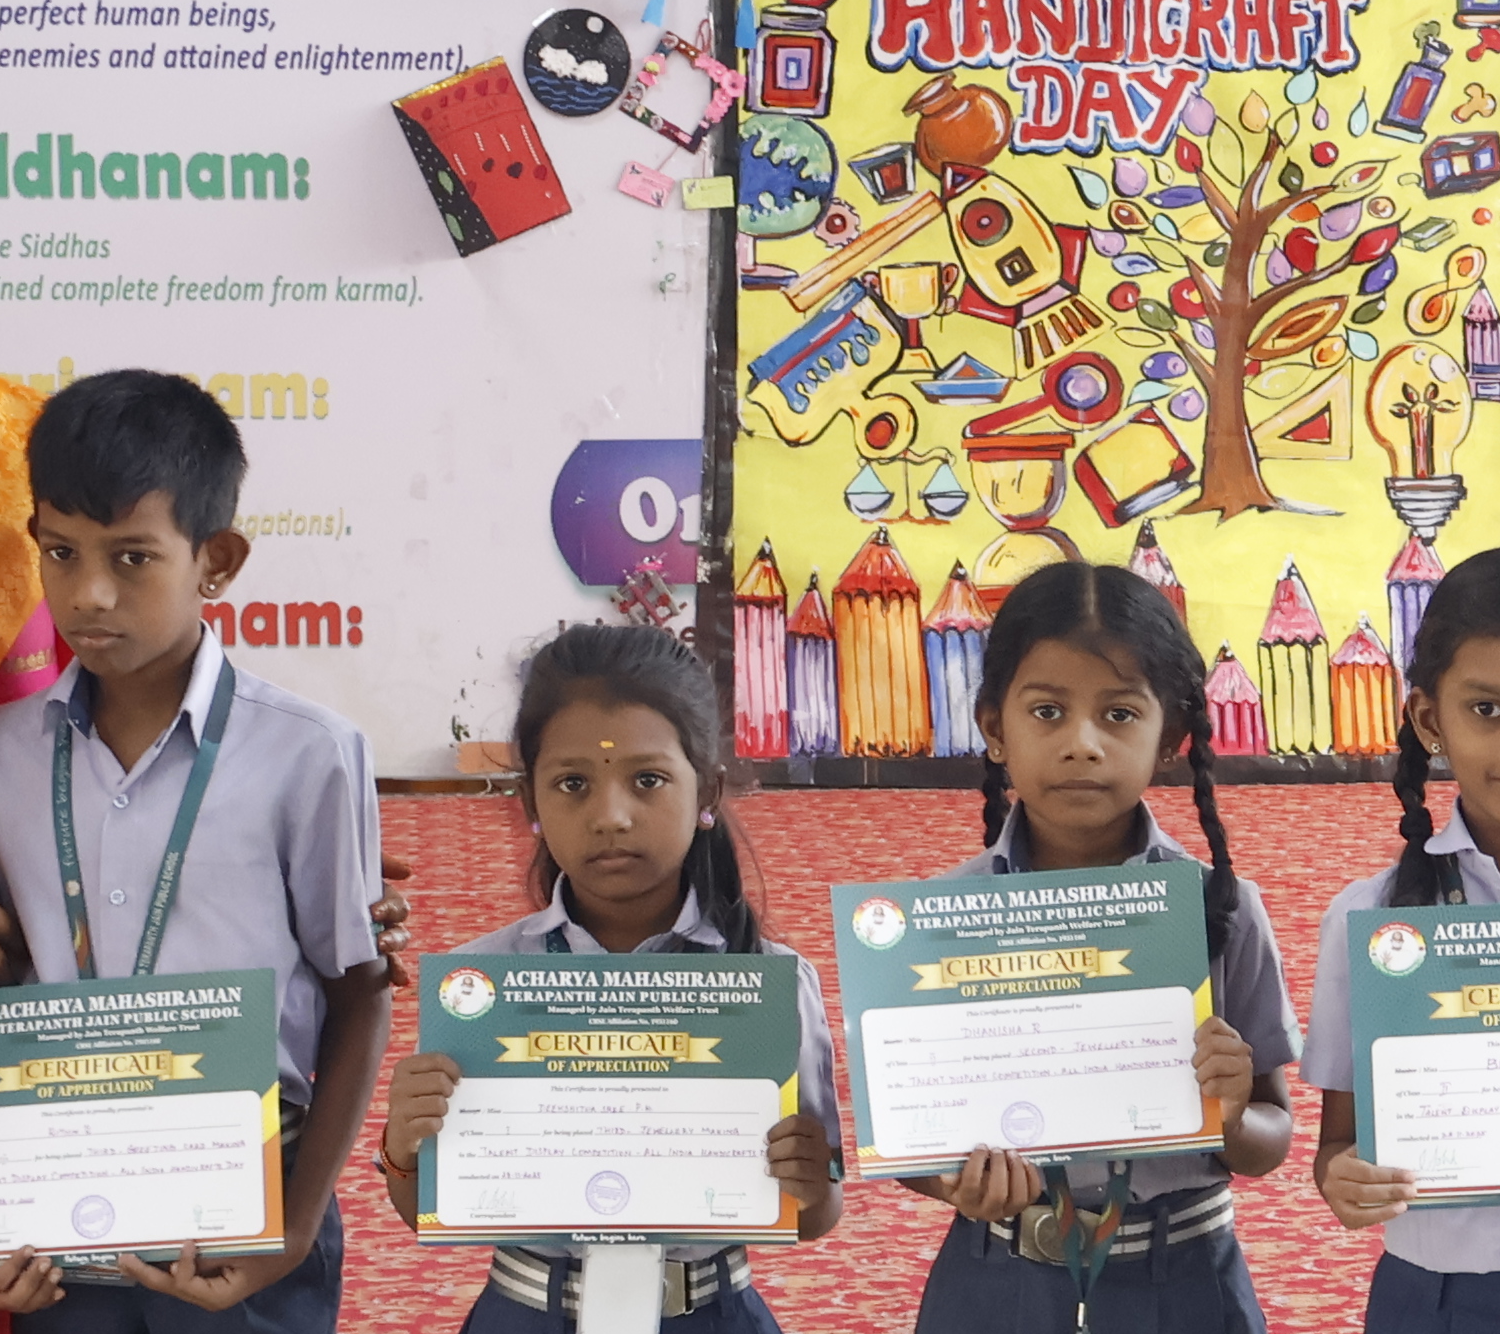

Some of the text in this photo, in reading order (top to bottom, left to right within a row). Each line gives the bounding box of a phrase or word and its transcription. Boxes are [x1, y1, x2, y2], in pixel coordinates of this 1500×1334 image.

[95, 0, 181, 28] human
[189, 2, 276, 32] beings,
[0, 45, 100, 69] enemies
[108, 44, 154, 70] and
[163, 45, 266, 71] attained
[1012, 64, 1199, 152] DAY
[19, 232, 110, 260] Siddhas
[52, 276, 157, 307] complete
[166, 274, 263, 305] freedom
[272, 274, 328, 307] from
[335, 276, 423, 307] karma).
[234, 507, 352, 541] egations).
[913, 880, 1167, 915] ACHARYA MAHASHRAMAN
[947, 949, 1094, 978] CERTIFICATE
[503, 971, 763, 989] ACHARYA MAHASHRAMAN
[89, 987, 243, 1012] MAHASHRAMAN
[503, 990, 762, 1004] TERAPANTH JAIN PUBLIC SCHOOL
[534, 1034, 685, 1056] CERTIFICATE
[25, 1052, 168, 1079] CERTIFICATE
[548, 1059, 670, 1073] OF APPRECIATION
